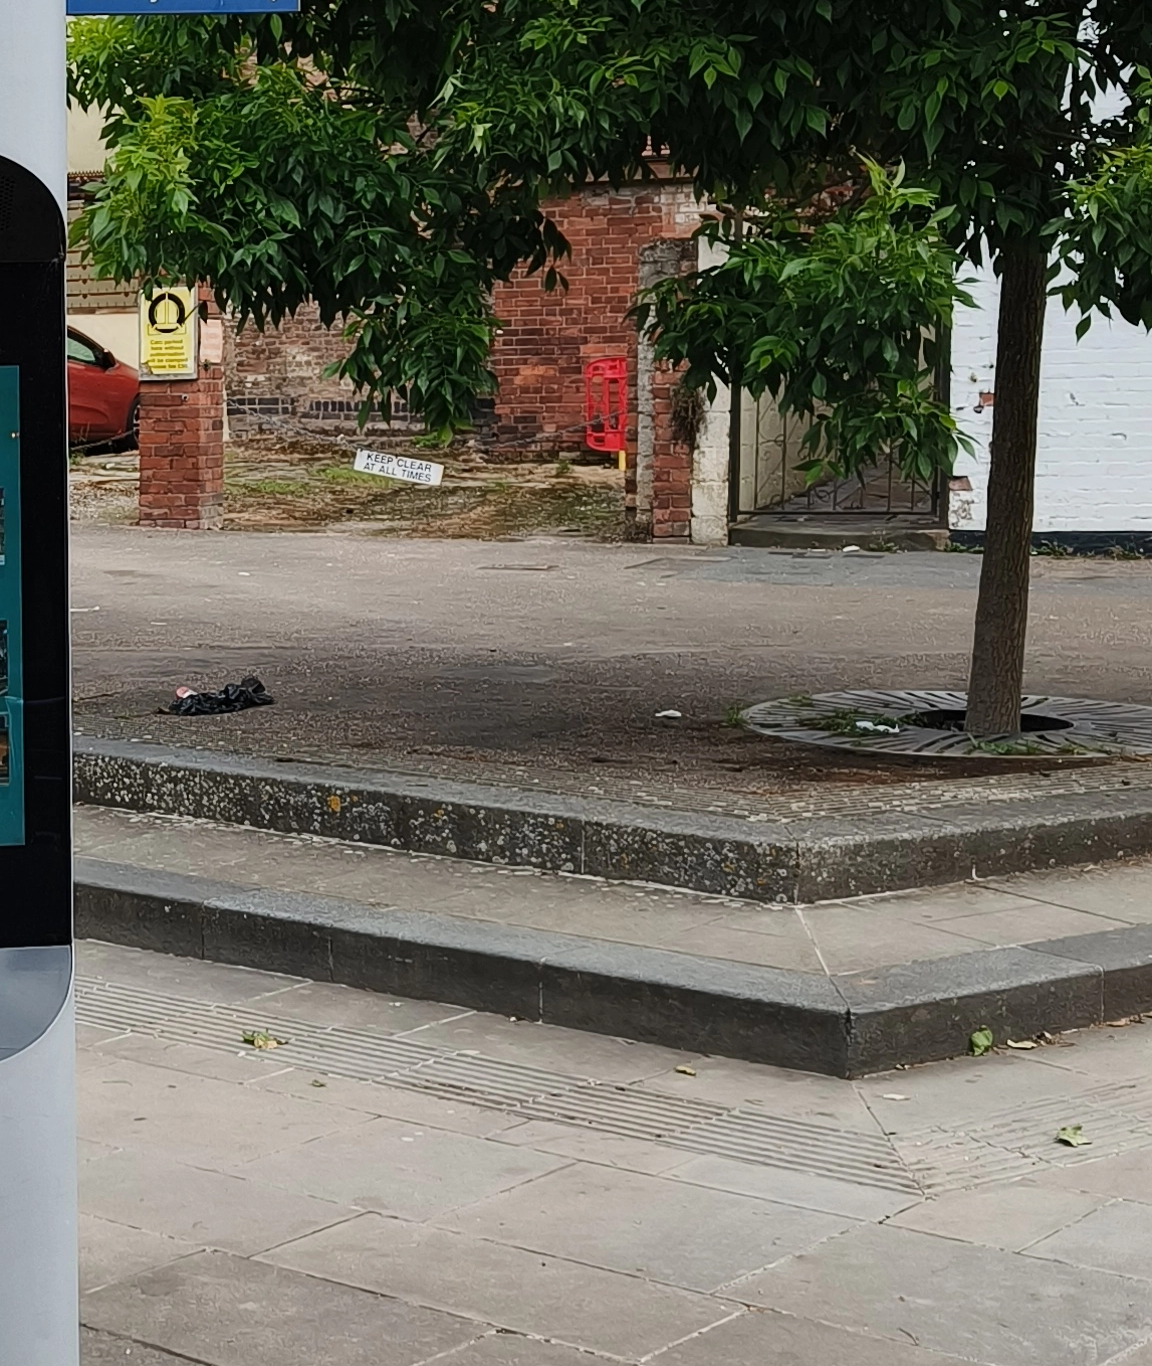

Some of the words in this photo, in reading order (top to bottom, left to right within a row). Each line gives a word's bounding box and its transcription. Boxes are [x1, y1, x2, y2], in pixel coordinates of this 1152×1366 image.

[363, 462, 376, 471] AT
[378, 465, 397, 476] ALL
[401, 469, 432, 483] TIMES
[367, 452, 394, 465] KEEP
[396, 458, 432, 473] CLEAR
